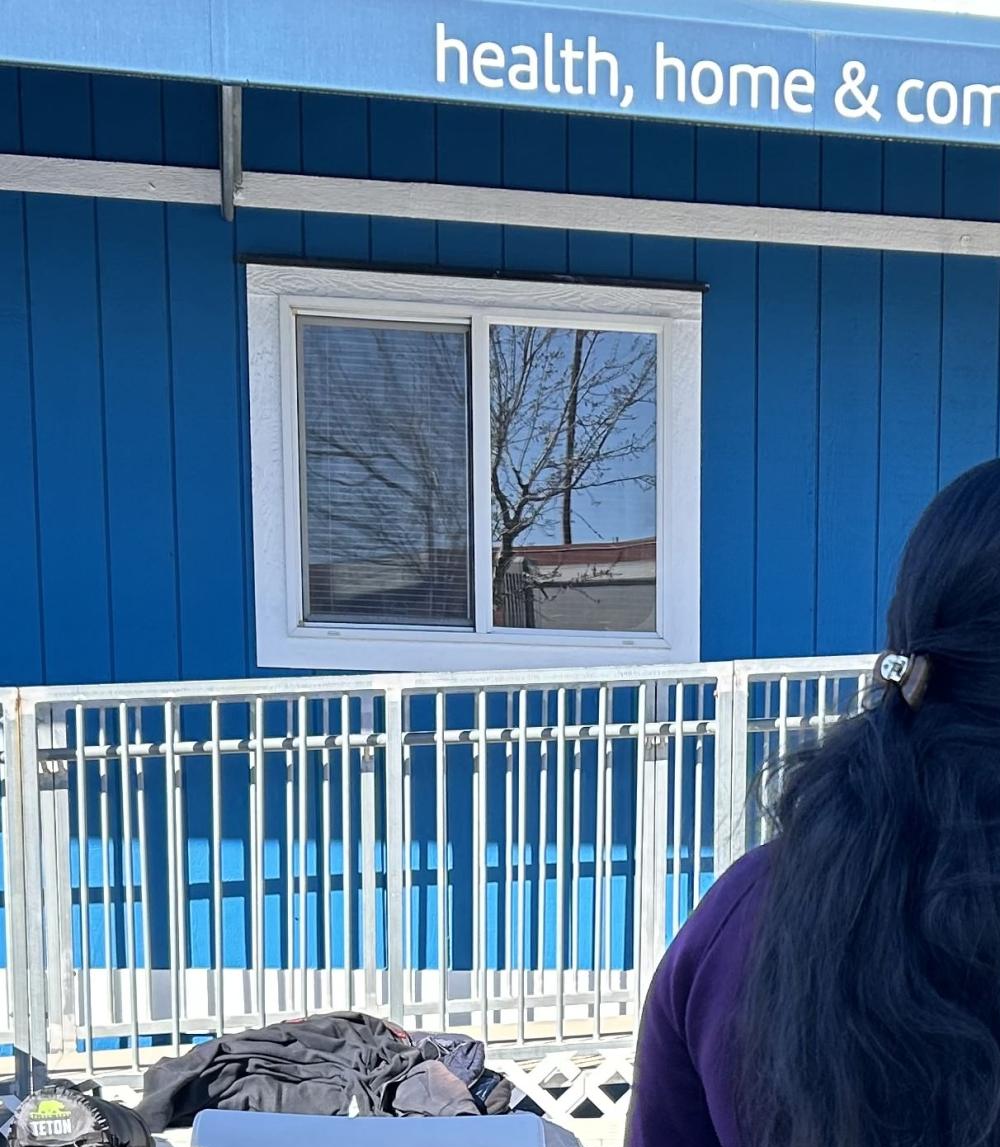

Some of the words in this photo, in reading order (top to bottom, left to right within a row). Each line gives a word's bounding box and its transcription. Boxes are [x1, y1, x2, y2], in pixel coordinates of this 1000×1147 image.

[436, 23, 634, 108] health,
[656, 42, 815, 114] home
[834, 60, 882, 122] &
[29, 1119, 72, 1137] TETON
